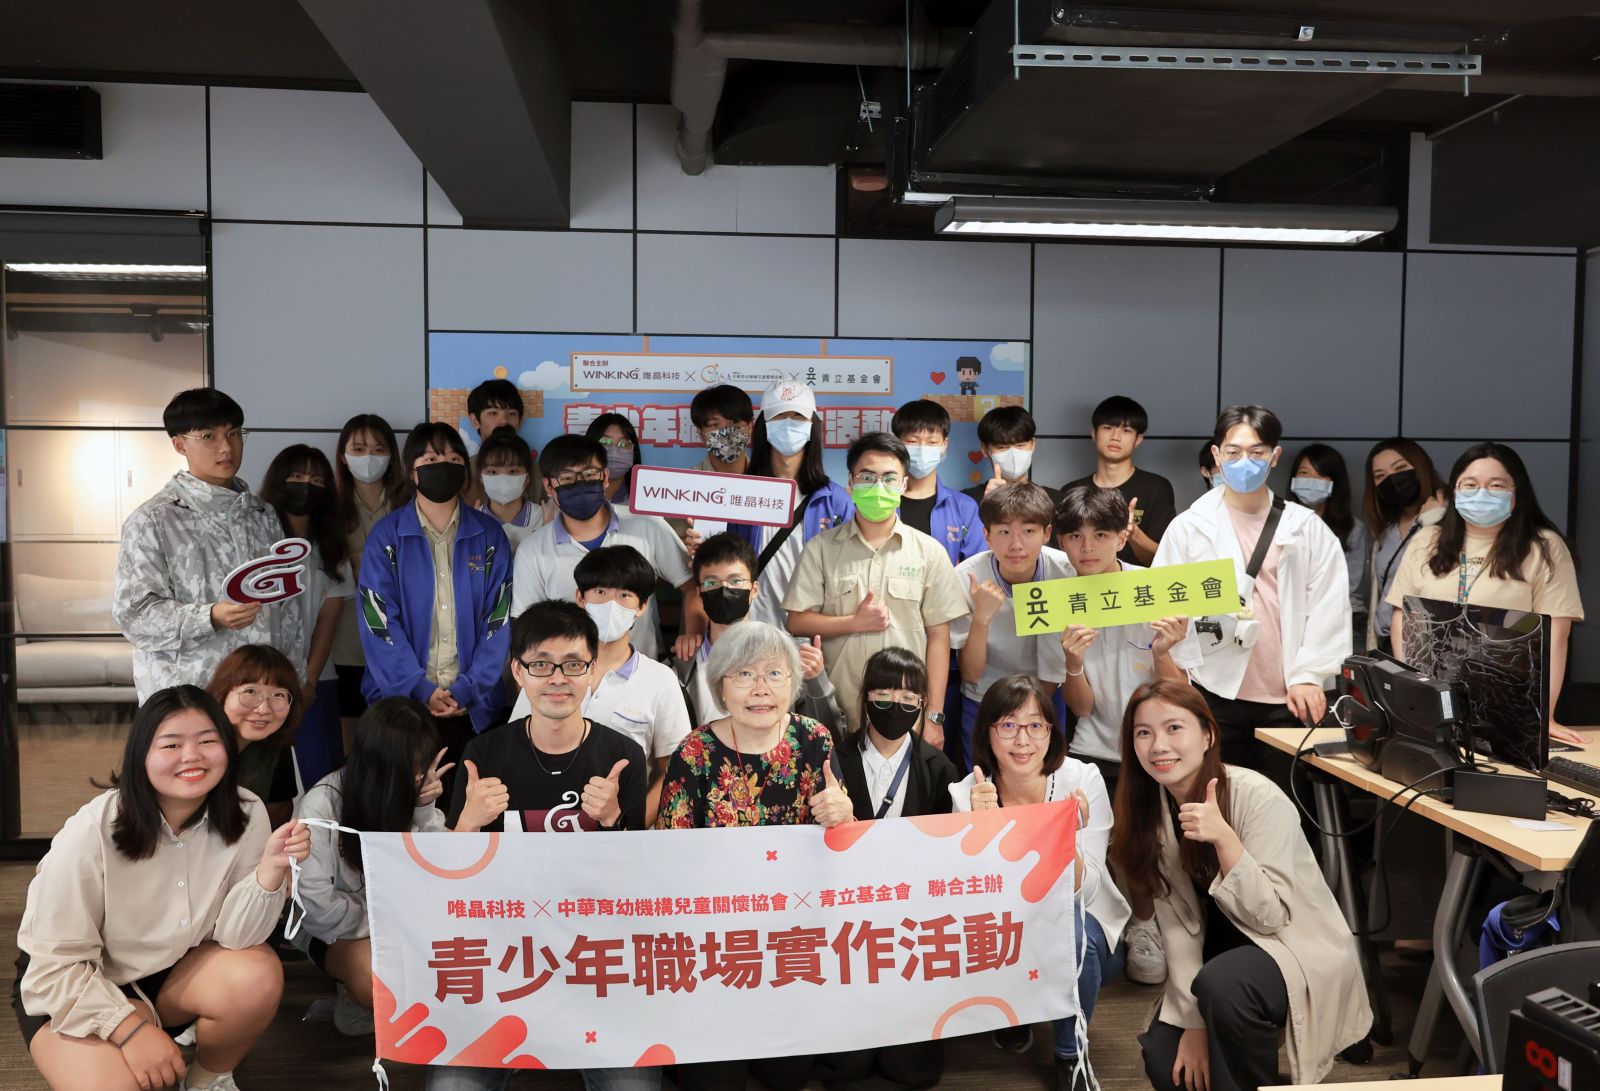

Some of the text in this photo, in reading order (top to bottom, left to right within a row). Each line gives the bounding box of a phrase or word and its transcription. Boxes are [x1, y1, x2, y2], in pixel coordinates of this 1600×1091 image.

[582, 367, 641, 380] WINKING
[642, 371, 681, 381] 唯晶科技
[821, 373, 881, 385] 青立基金會
[642, 486, 785, 510] WINKING 唯晶科技
[1068, 576, 1223, 615] 青立基金會
[447, 873, 1004, 919] 唯晶科技 中華育幼機構兒童關懷協會 青立基金會 聯合主辦
[428, 911, 1024, 1005] 青少年職場實作活動
